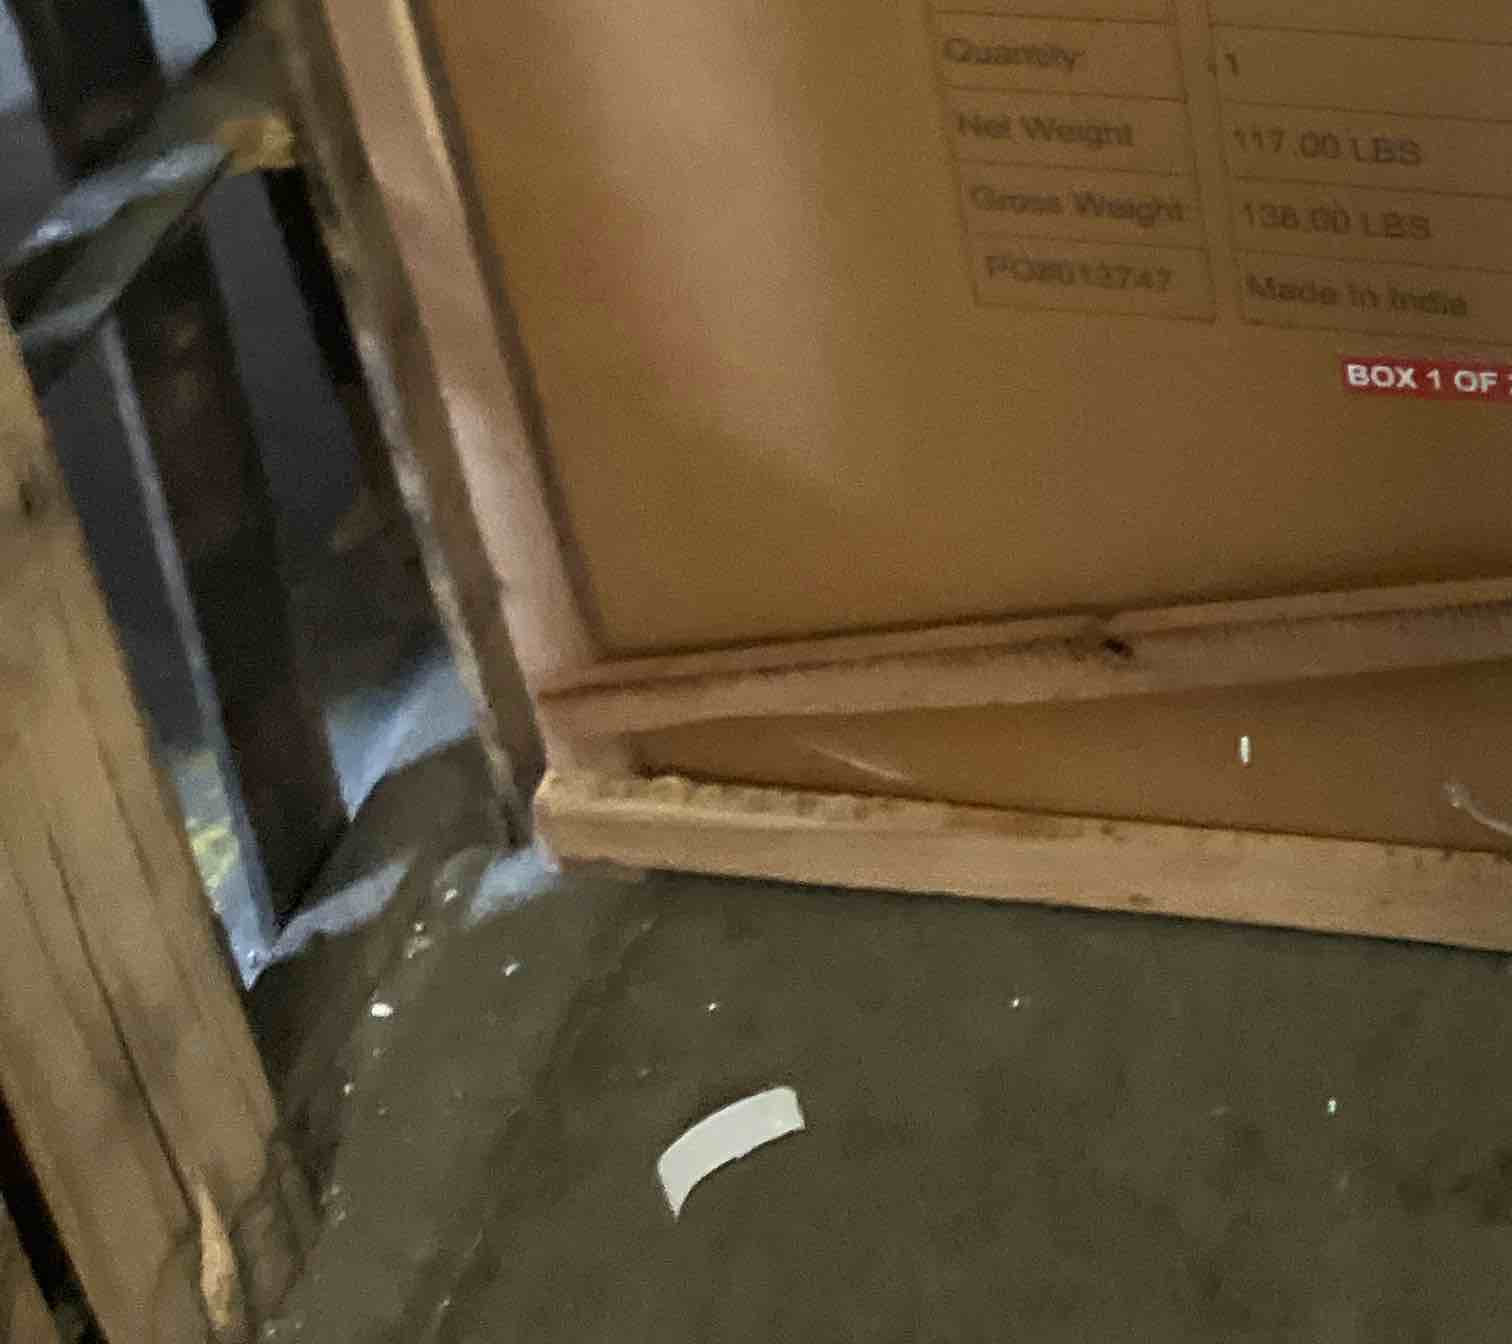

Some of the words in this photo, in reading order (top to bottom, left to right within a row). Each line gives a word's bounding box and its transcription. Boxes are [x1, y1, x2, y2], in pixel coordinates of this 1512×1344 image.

[1349, 136, 1422, 167] LBS
[1346, 363, 1418, 390] BOX
[1425, 368, 1441, 391] 1
[1453, 369, 1499, 394] OF
